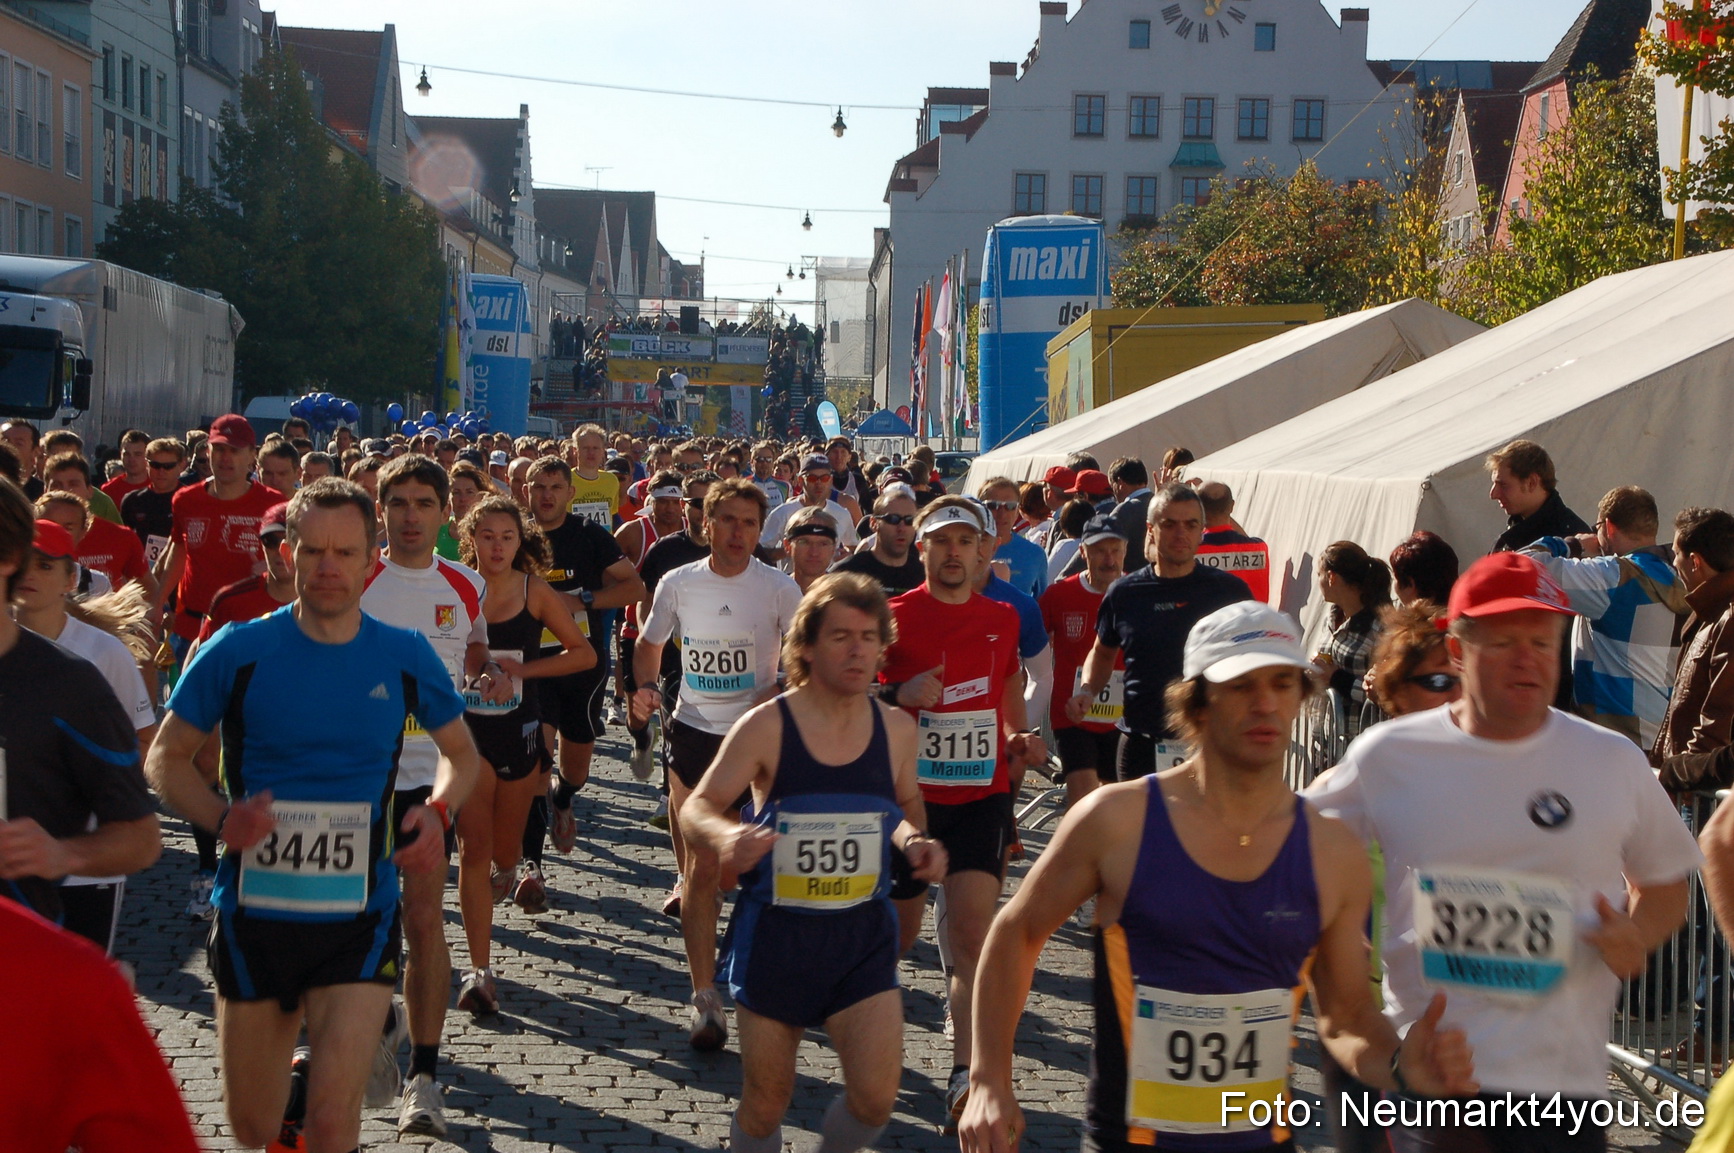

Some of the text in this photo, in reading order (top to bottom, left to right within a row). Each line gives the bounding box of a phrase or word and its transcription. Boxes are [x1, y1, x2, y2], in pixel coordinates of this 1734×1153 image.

[1008, 238, 1091, 281] maxi
[472, 292, 514, 321] axi
[486, 335, 510, 353] dsl
[474, 363, 489, 418] sl.de
[688, 649, 748, 675] 3260
[698, 675, 741, 690] Robert
[955, 684, 977, 697] DEHN
[930, 718, 965, 727] PFLEIDERER
[925, 730, 990, 760] 3115
[931, 760, 985, 777] Manuel
[271, 811, 317, 824] LEIDERER
[256, 830, 355, 872] 3445
[796, 838, 859, 874] 559
[806, 876, 851, 896] Rudi
[1432, 898, 1554, 958] 3228
[1158, 1001, 1228, 1019] PFLEIDERER
[1166, 1029, 1261, 1083] 934
